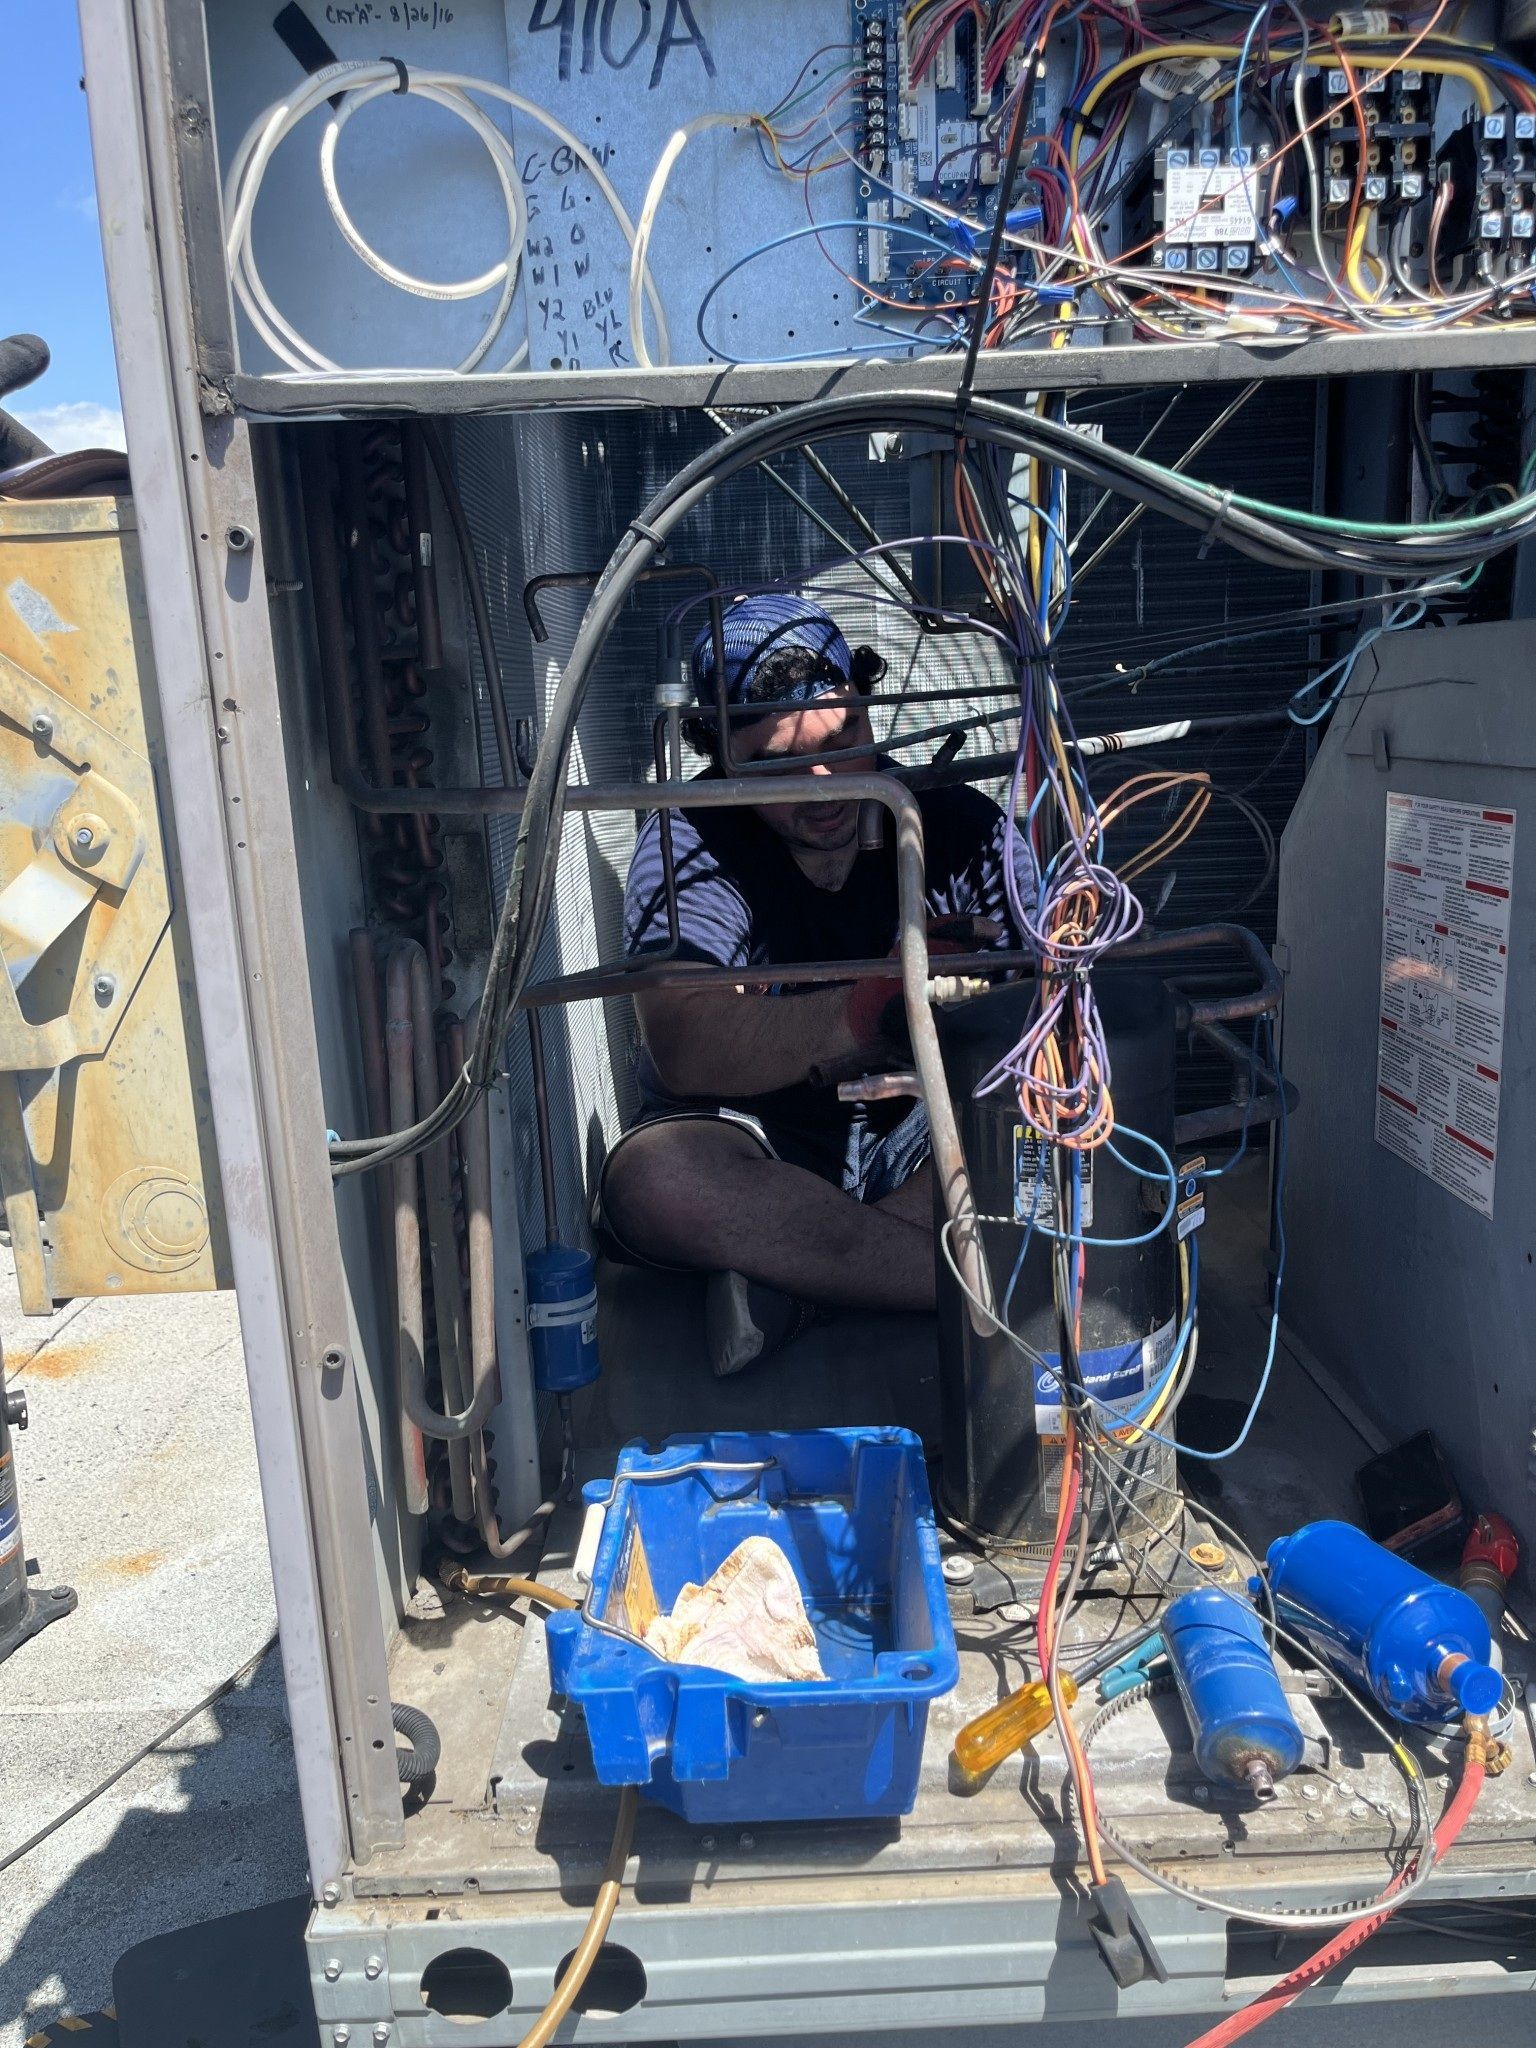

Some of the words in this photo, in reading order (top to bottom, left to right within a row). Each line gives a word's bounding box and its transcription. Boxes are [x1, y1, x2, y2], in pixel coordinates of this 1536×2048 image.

[390, 2, 454, 30] 8/26/16
[528, 0, 717, 90] 410A
[939, 171, 970, 179] OCCUPAN
[932, 279, 961, 287] CIRCUIT
[538, 297, 566, 332] Y2
